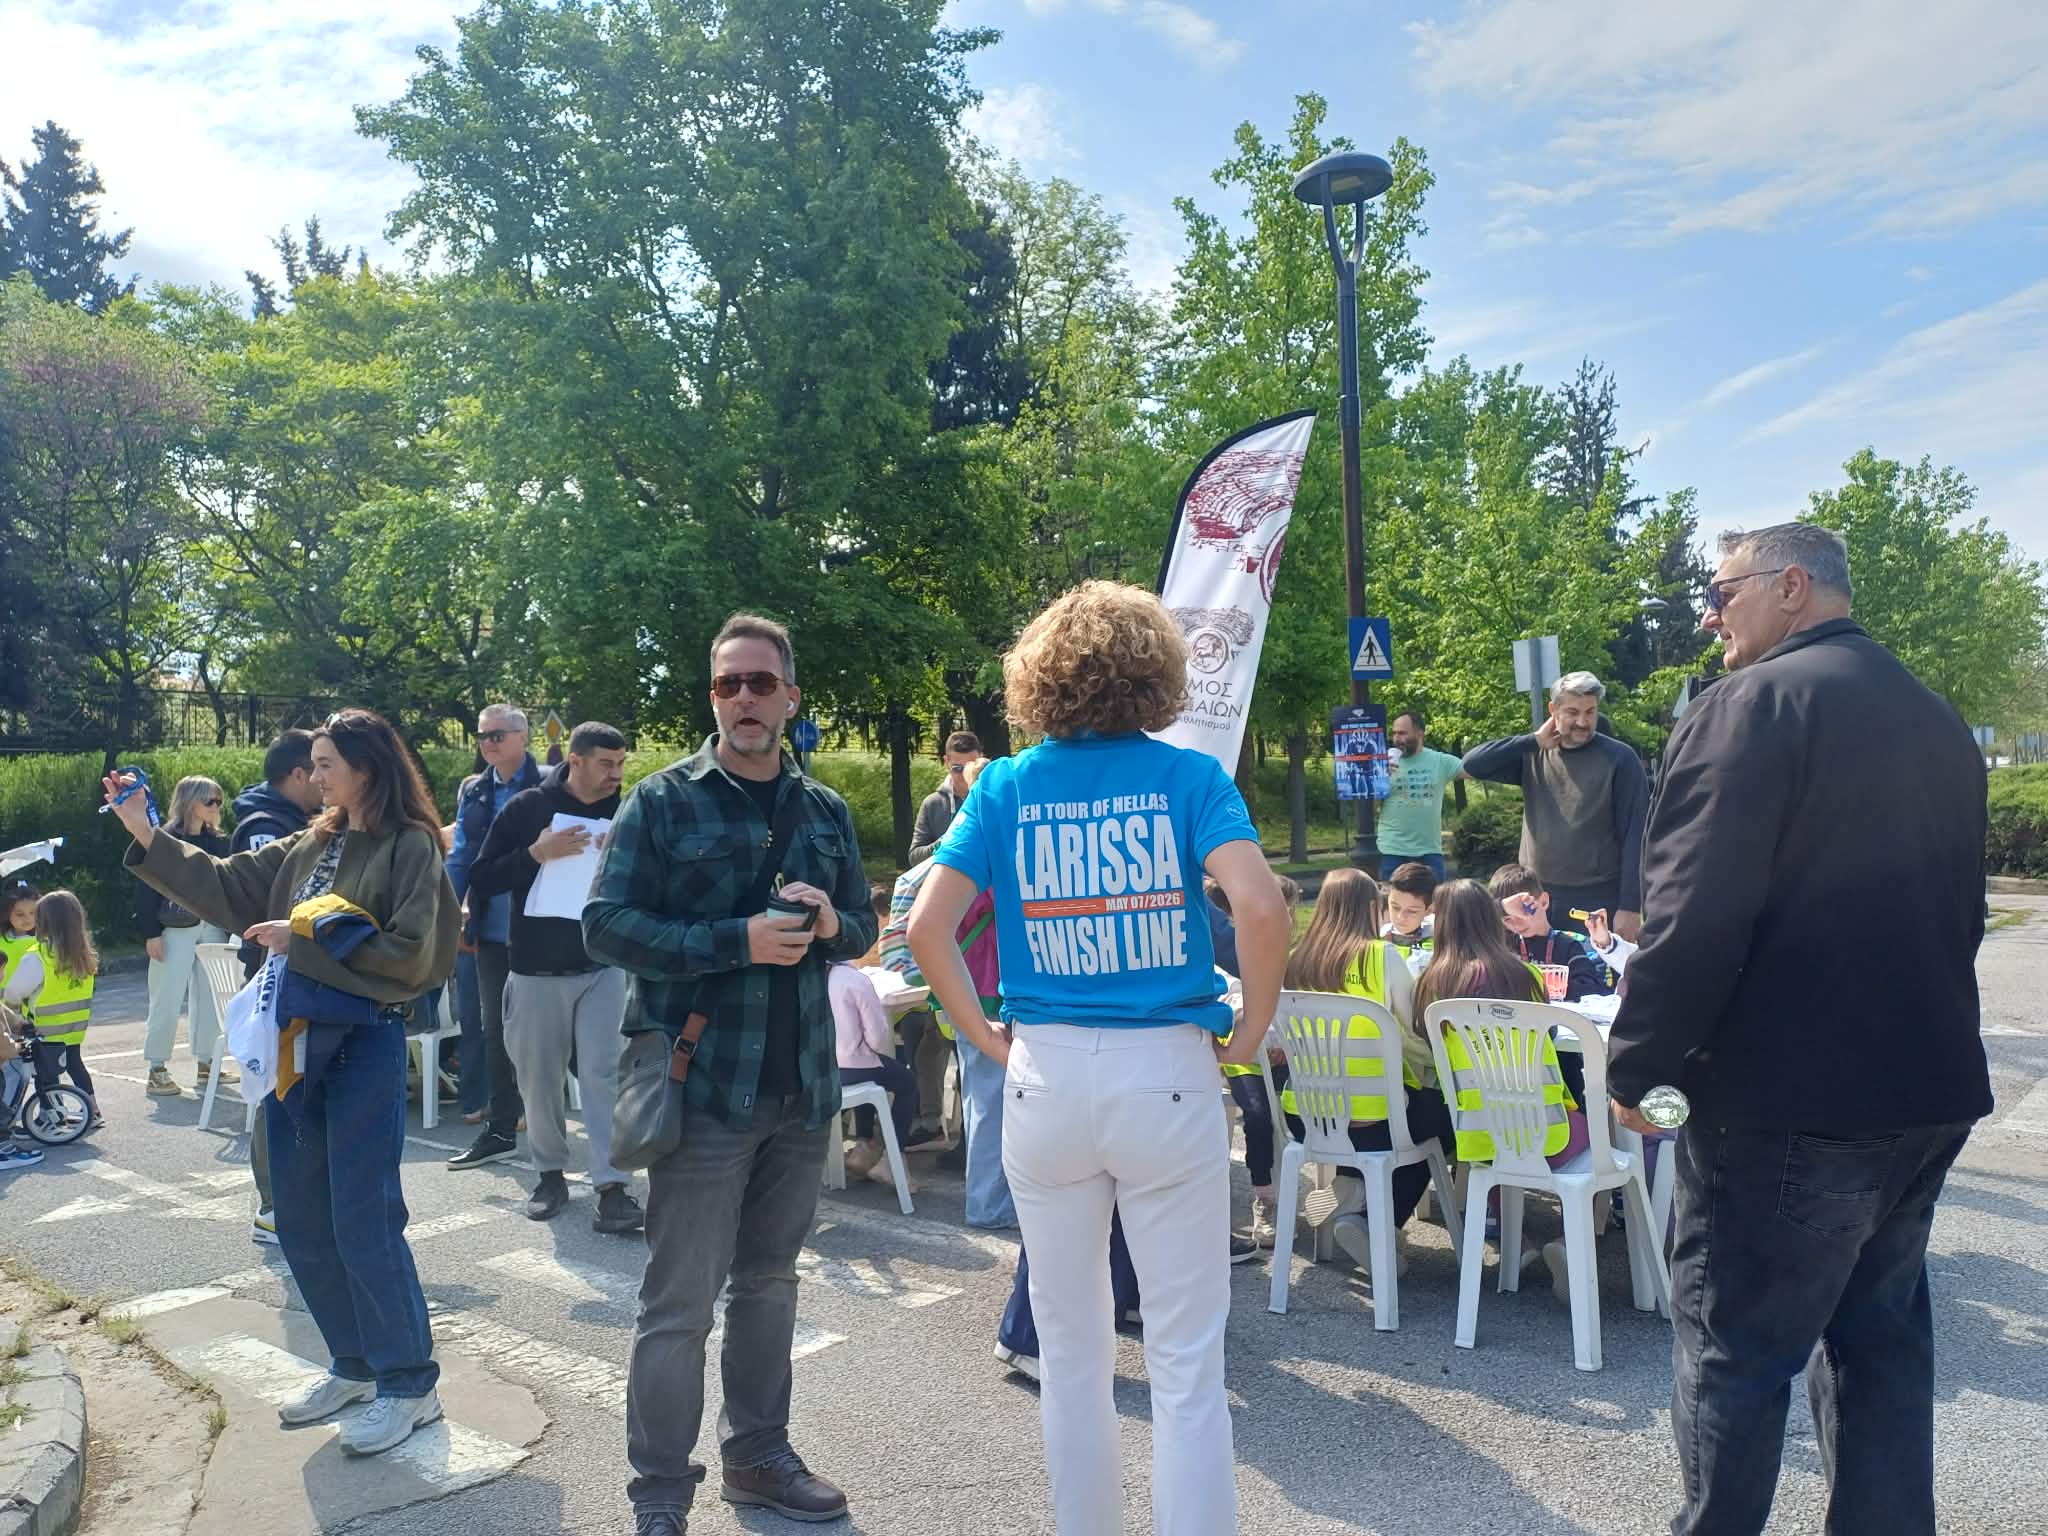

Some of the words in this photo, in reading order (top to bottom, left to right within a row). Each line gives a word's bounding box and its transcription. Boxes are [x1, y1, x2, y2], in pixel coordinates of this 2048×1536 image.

[1186, 679, 1232, 698] ΜΟΣ
[1044, 801, 1089, 820] TOUR
[1093, 798, 1109, 817] OF
[1112, 793, 1168, 813] HELLAS
[1015, 814, 1183, 900] LARISSA
[1105, 896, 1128, 911] MAY
[1130, 892, 1180, 909] 07/2026
[1024, 915, 1120, 976] FINISH
[1123, 909, 1188, 971] LINE
